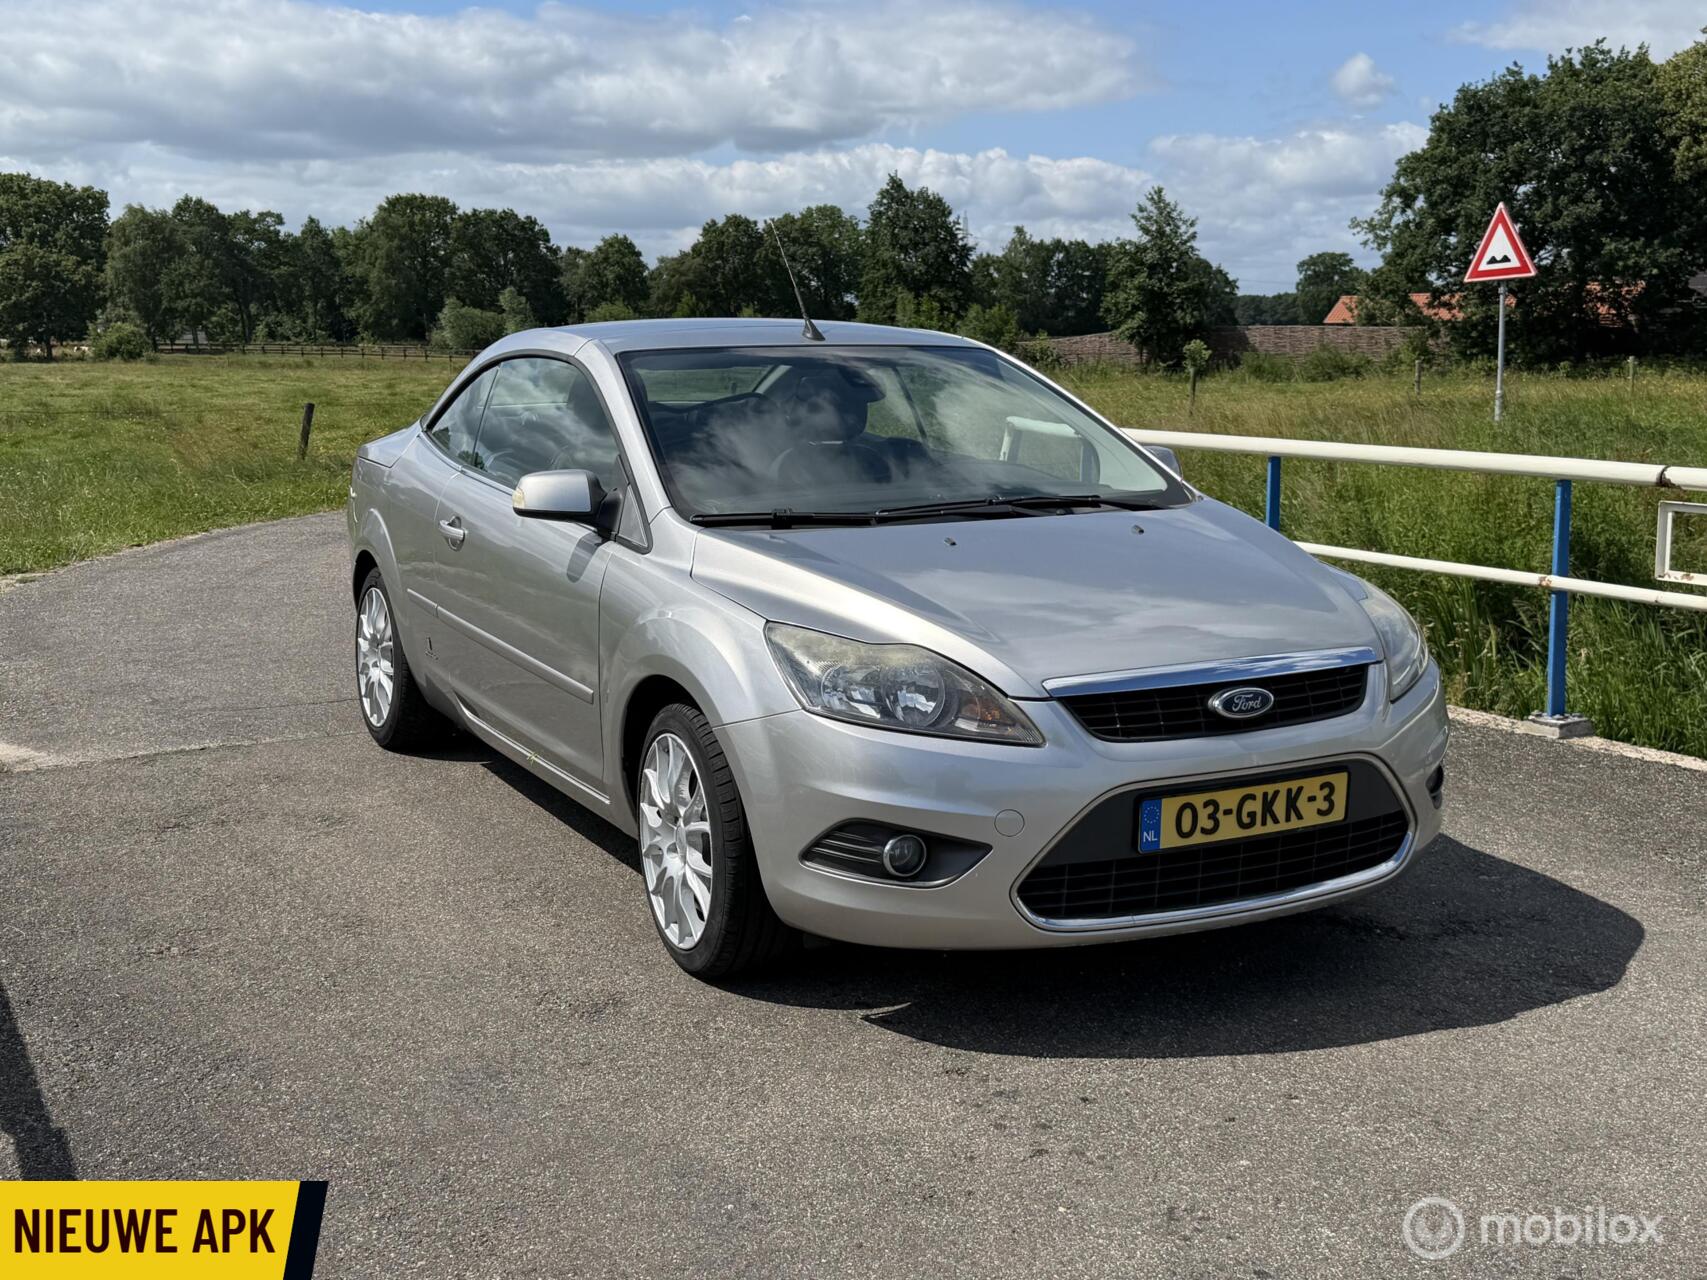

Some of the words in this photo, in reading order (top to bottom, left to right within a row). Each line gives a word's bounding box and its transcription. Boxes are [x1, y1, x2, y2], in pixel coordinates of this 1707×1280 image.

[1232, 694, 1261, 712] Ford
[1175, 781, 1336, 839] 03-GKK-3
[1143, 830, 1158, 842] NL
